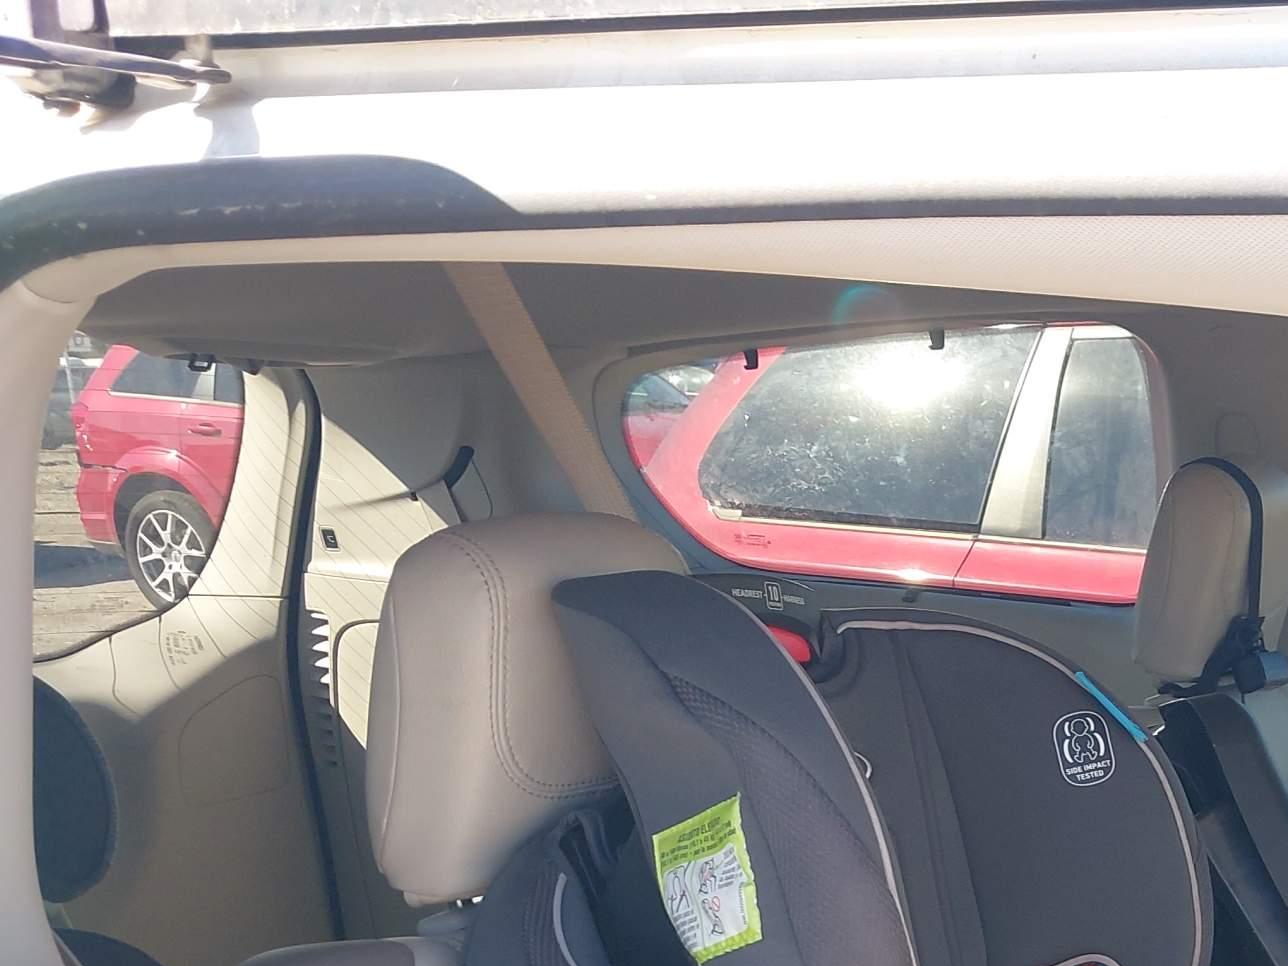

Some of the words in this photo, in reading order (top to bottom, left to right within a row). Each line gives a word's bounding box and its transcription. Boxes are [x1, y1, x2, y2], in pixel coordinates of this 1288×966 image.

[731, 588, 763, 599] HEADREST
[768, 586, 779, 601] 10
[1066, 766, 1083, 774] SIDE
[1084, 760, 1111, 770] IMPACT
[1076, 770, 1104, 780] TESTED
